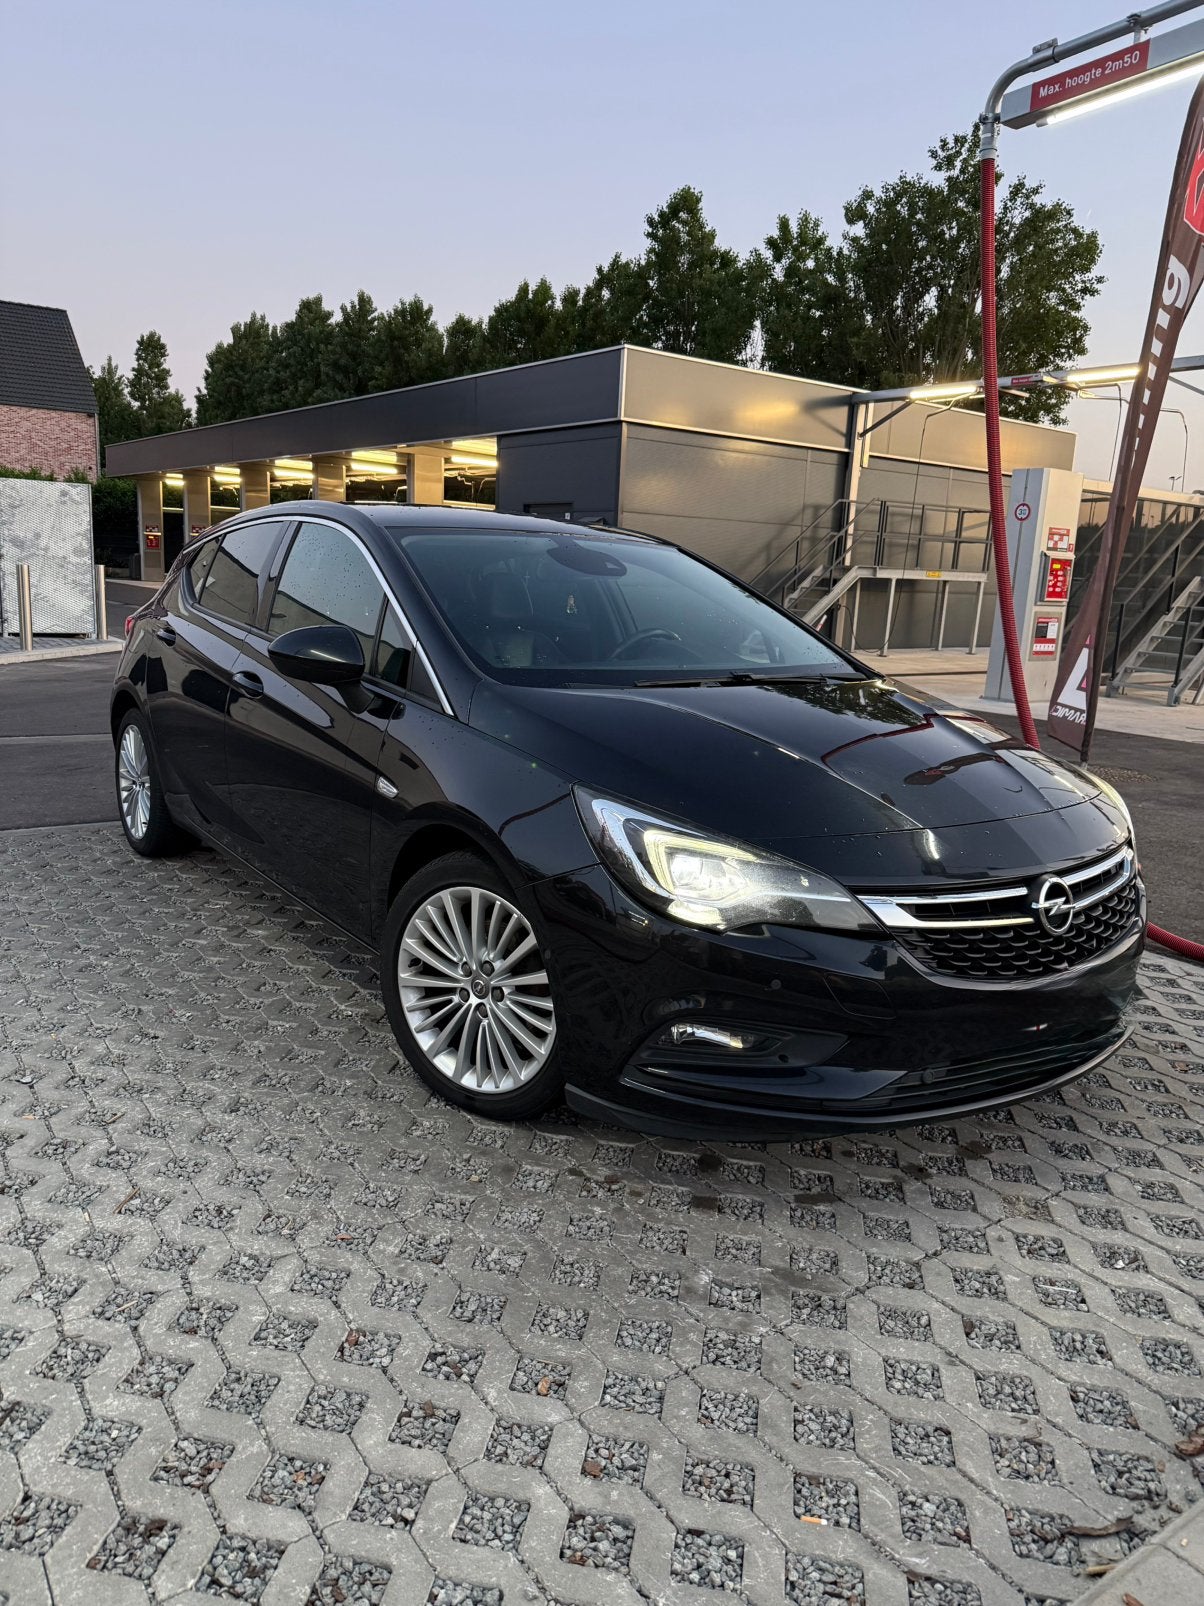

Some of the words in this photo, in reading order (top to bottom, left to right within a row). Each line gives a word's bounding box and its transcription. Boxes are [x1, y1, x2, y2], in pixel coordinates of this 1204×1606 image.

[1039, 83, 1062, 97] Max.
[1065, 68, 1102, 88] hoogte
[1105, 51, 1140, 74] 2m50
